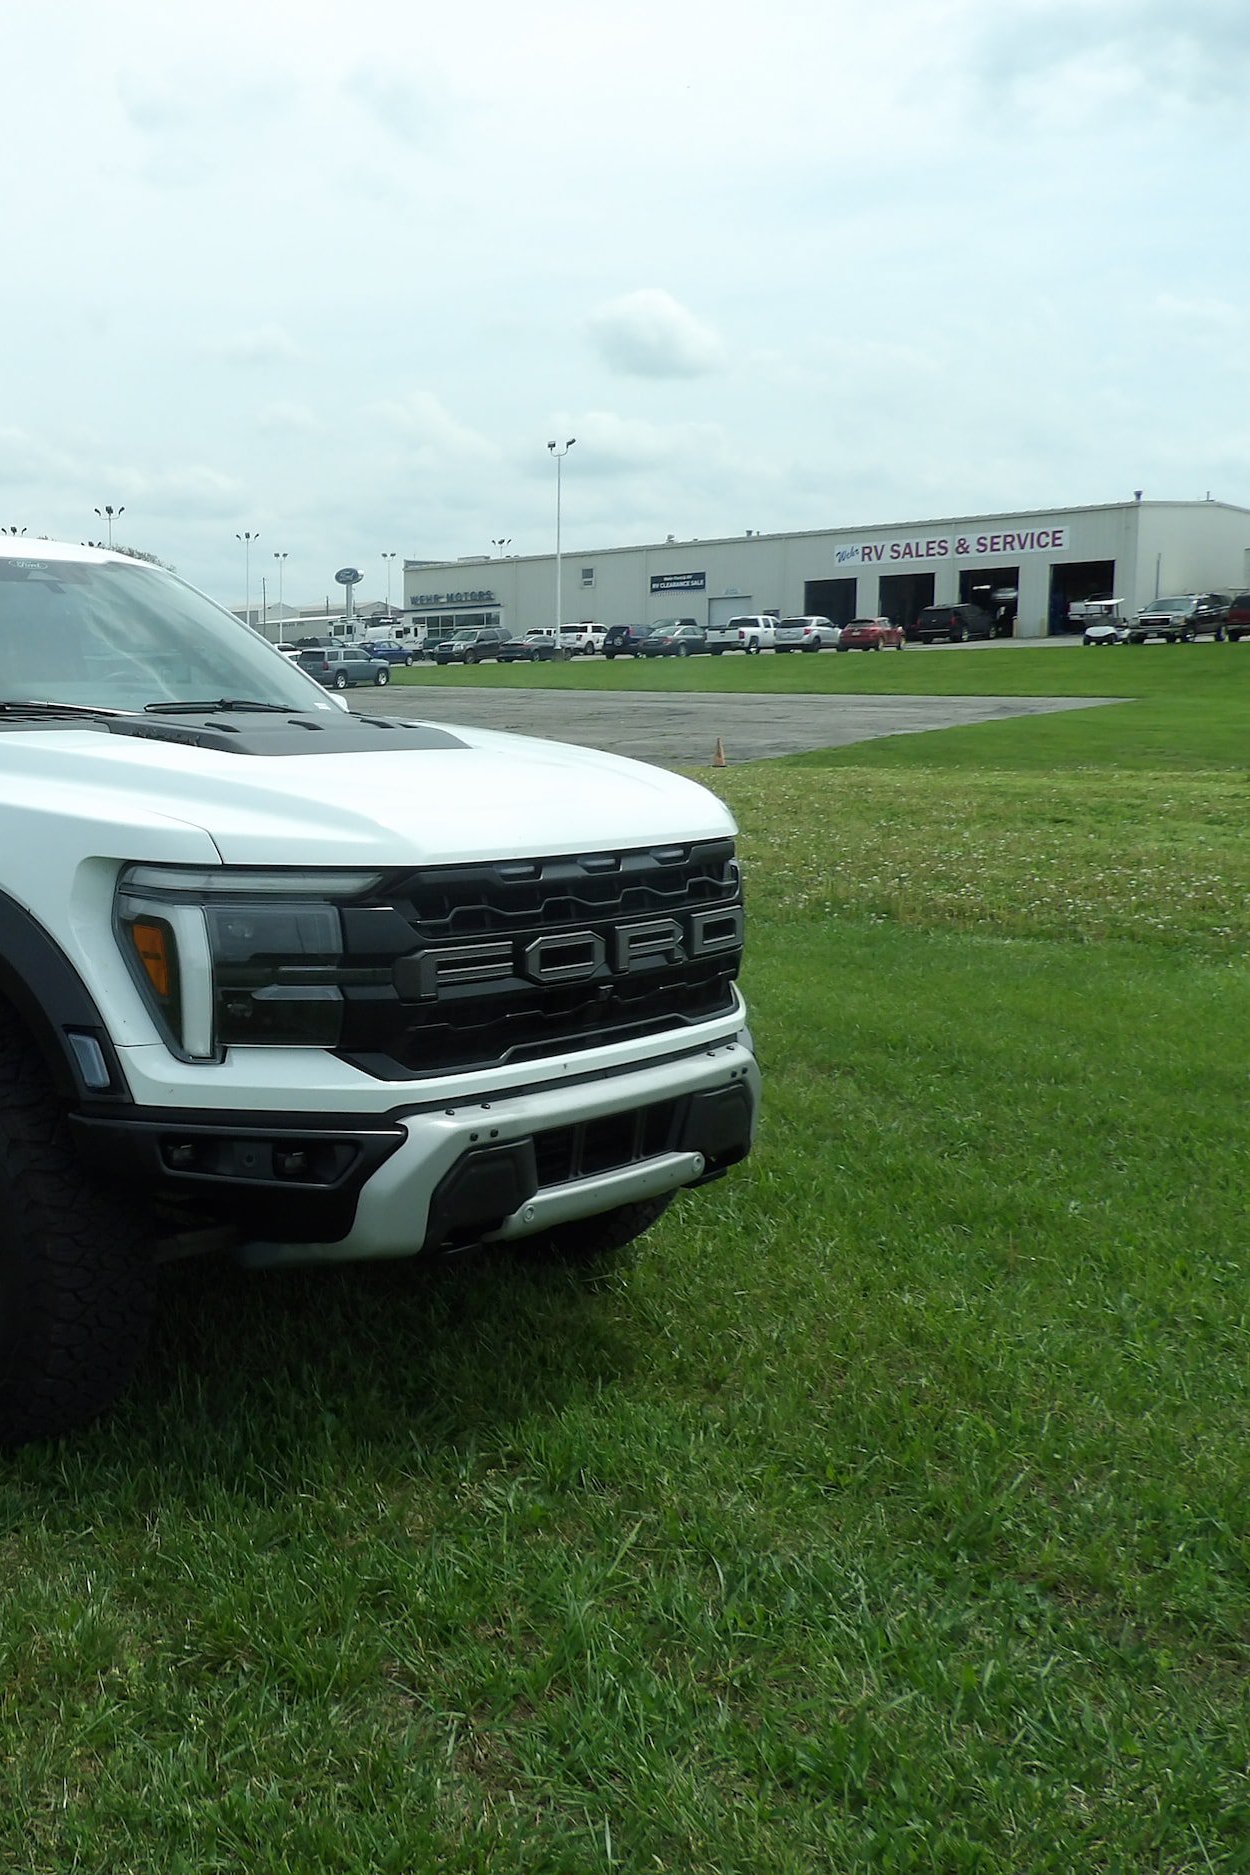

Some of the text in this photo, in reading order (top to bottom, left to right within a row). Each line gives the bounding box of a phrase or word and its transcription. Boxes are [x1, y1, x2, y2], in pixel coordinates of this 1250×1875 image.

[861, 544, 885, 562] RV
[889, 539, 949, 560] SALES
[955, 537, 970, 555] &
[975, 530, 1064, 553] SERVICE
[446, 590, 495, 602] MOTORS
[419, 905, 744, 1000] FORD
